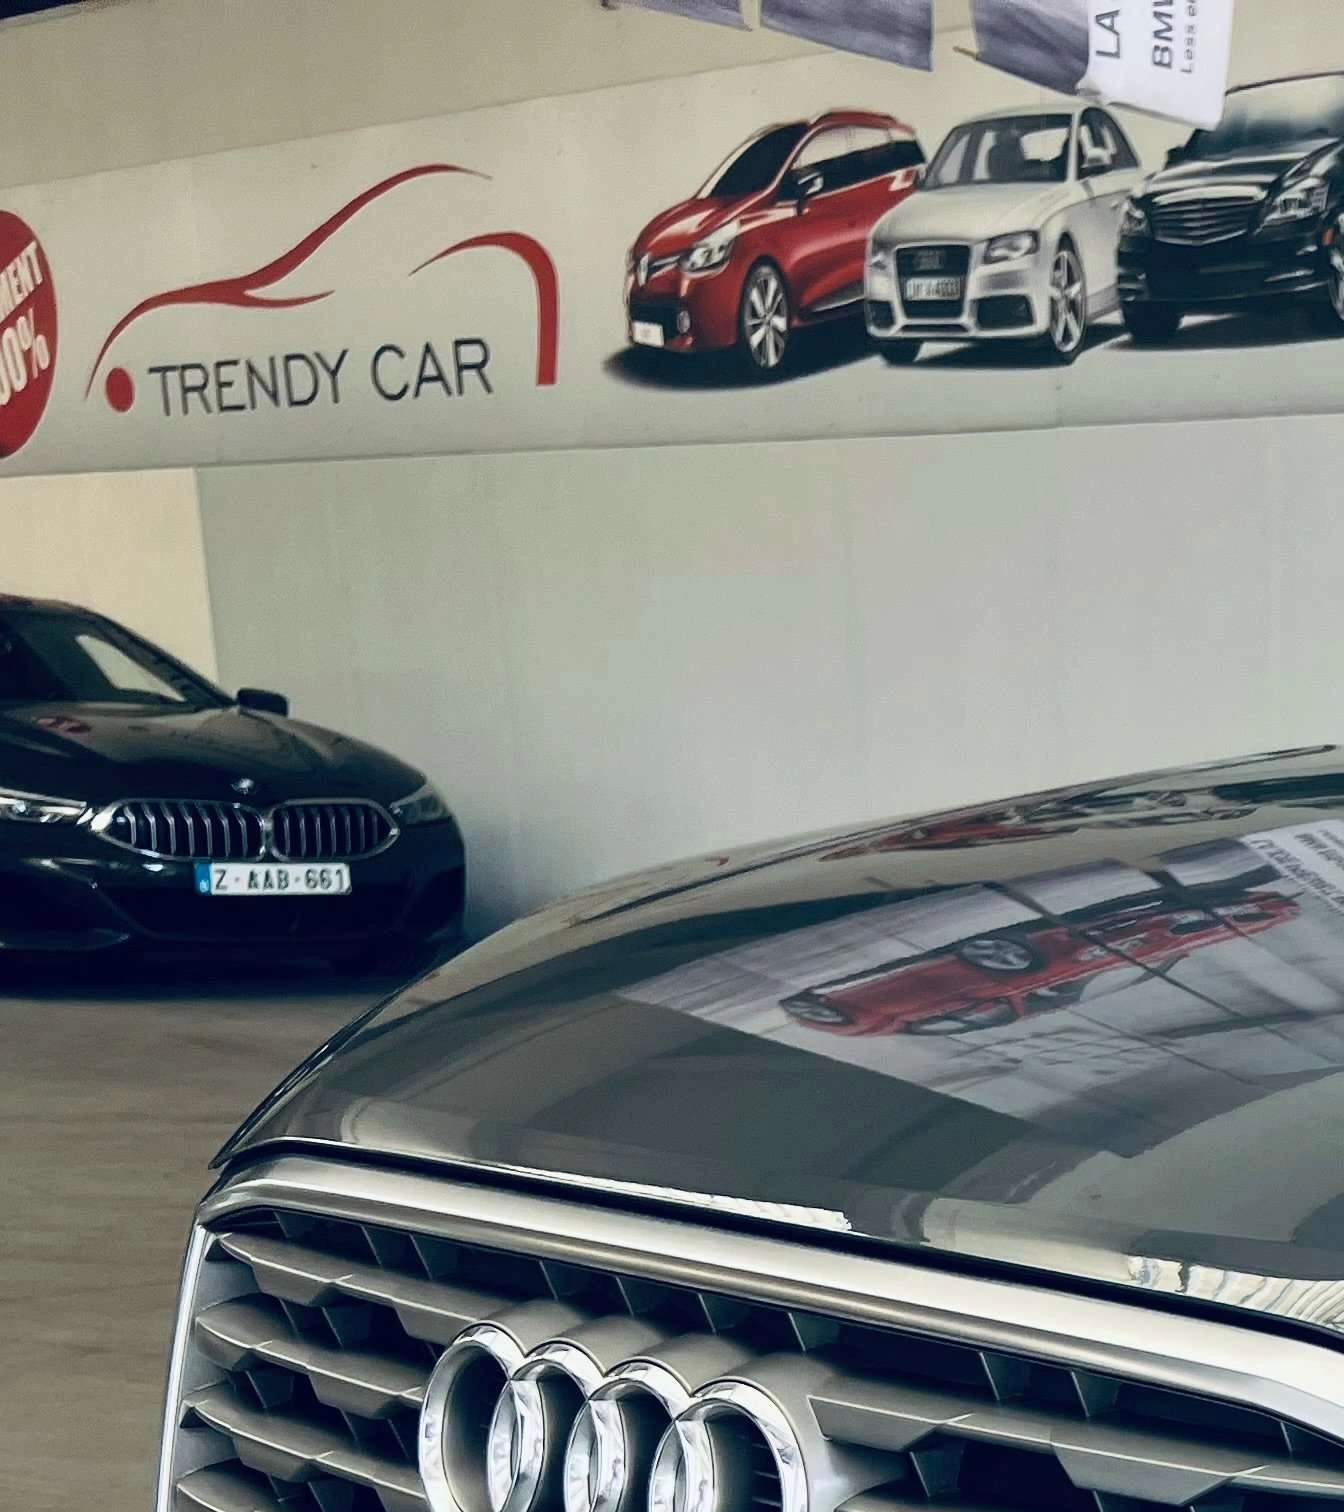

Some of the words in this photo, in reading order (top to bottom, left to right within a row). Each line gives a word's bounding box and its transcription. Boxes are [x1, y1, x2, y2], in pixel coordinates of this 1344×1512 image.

[1152, 0, 1174, 69] BM
[148, 349, 348, 417] TRENDY
[371, 338, 495, 402] CAR
